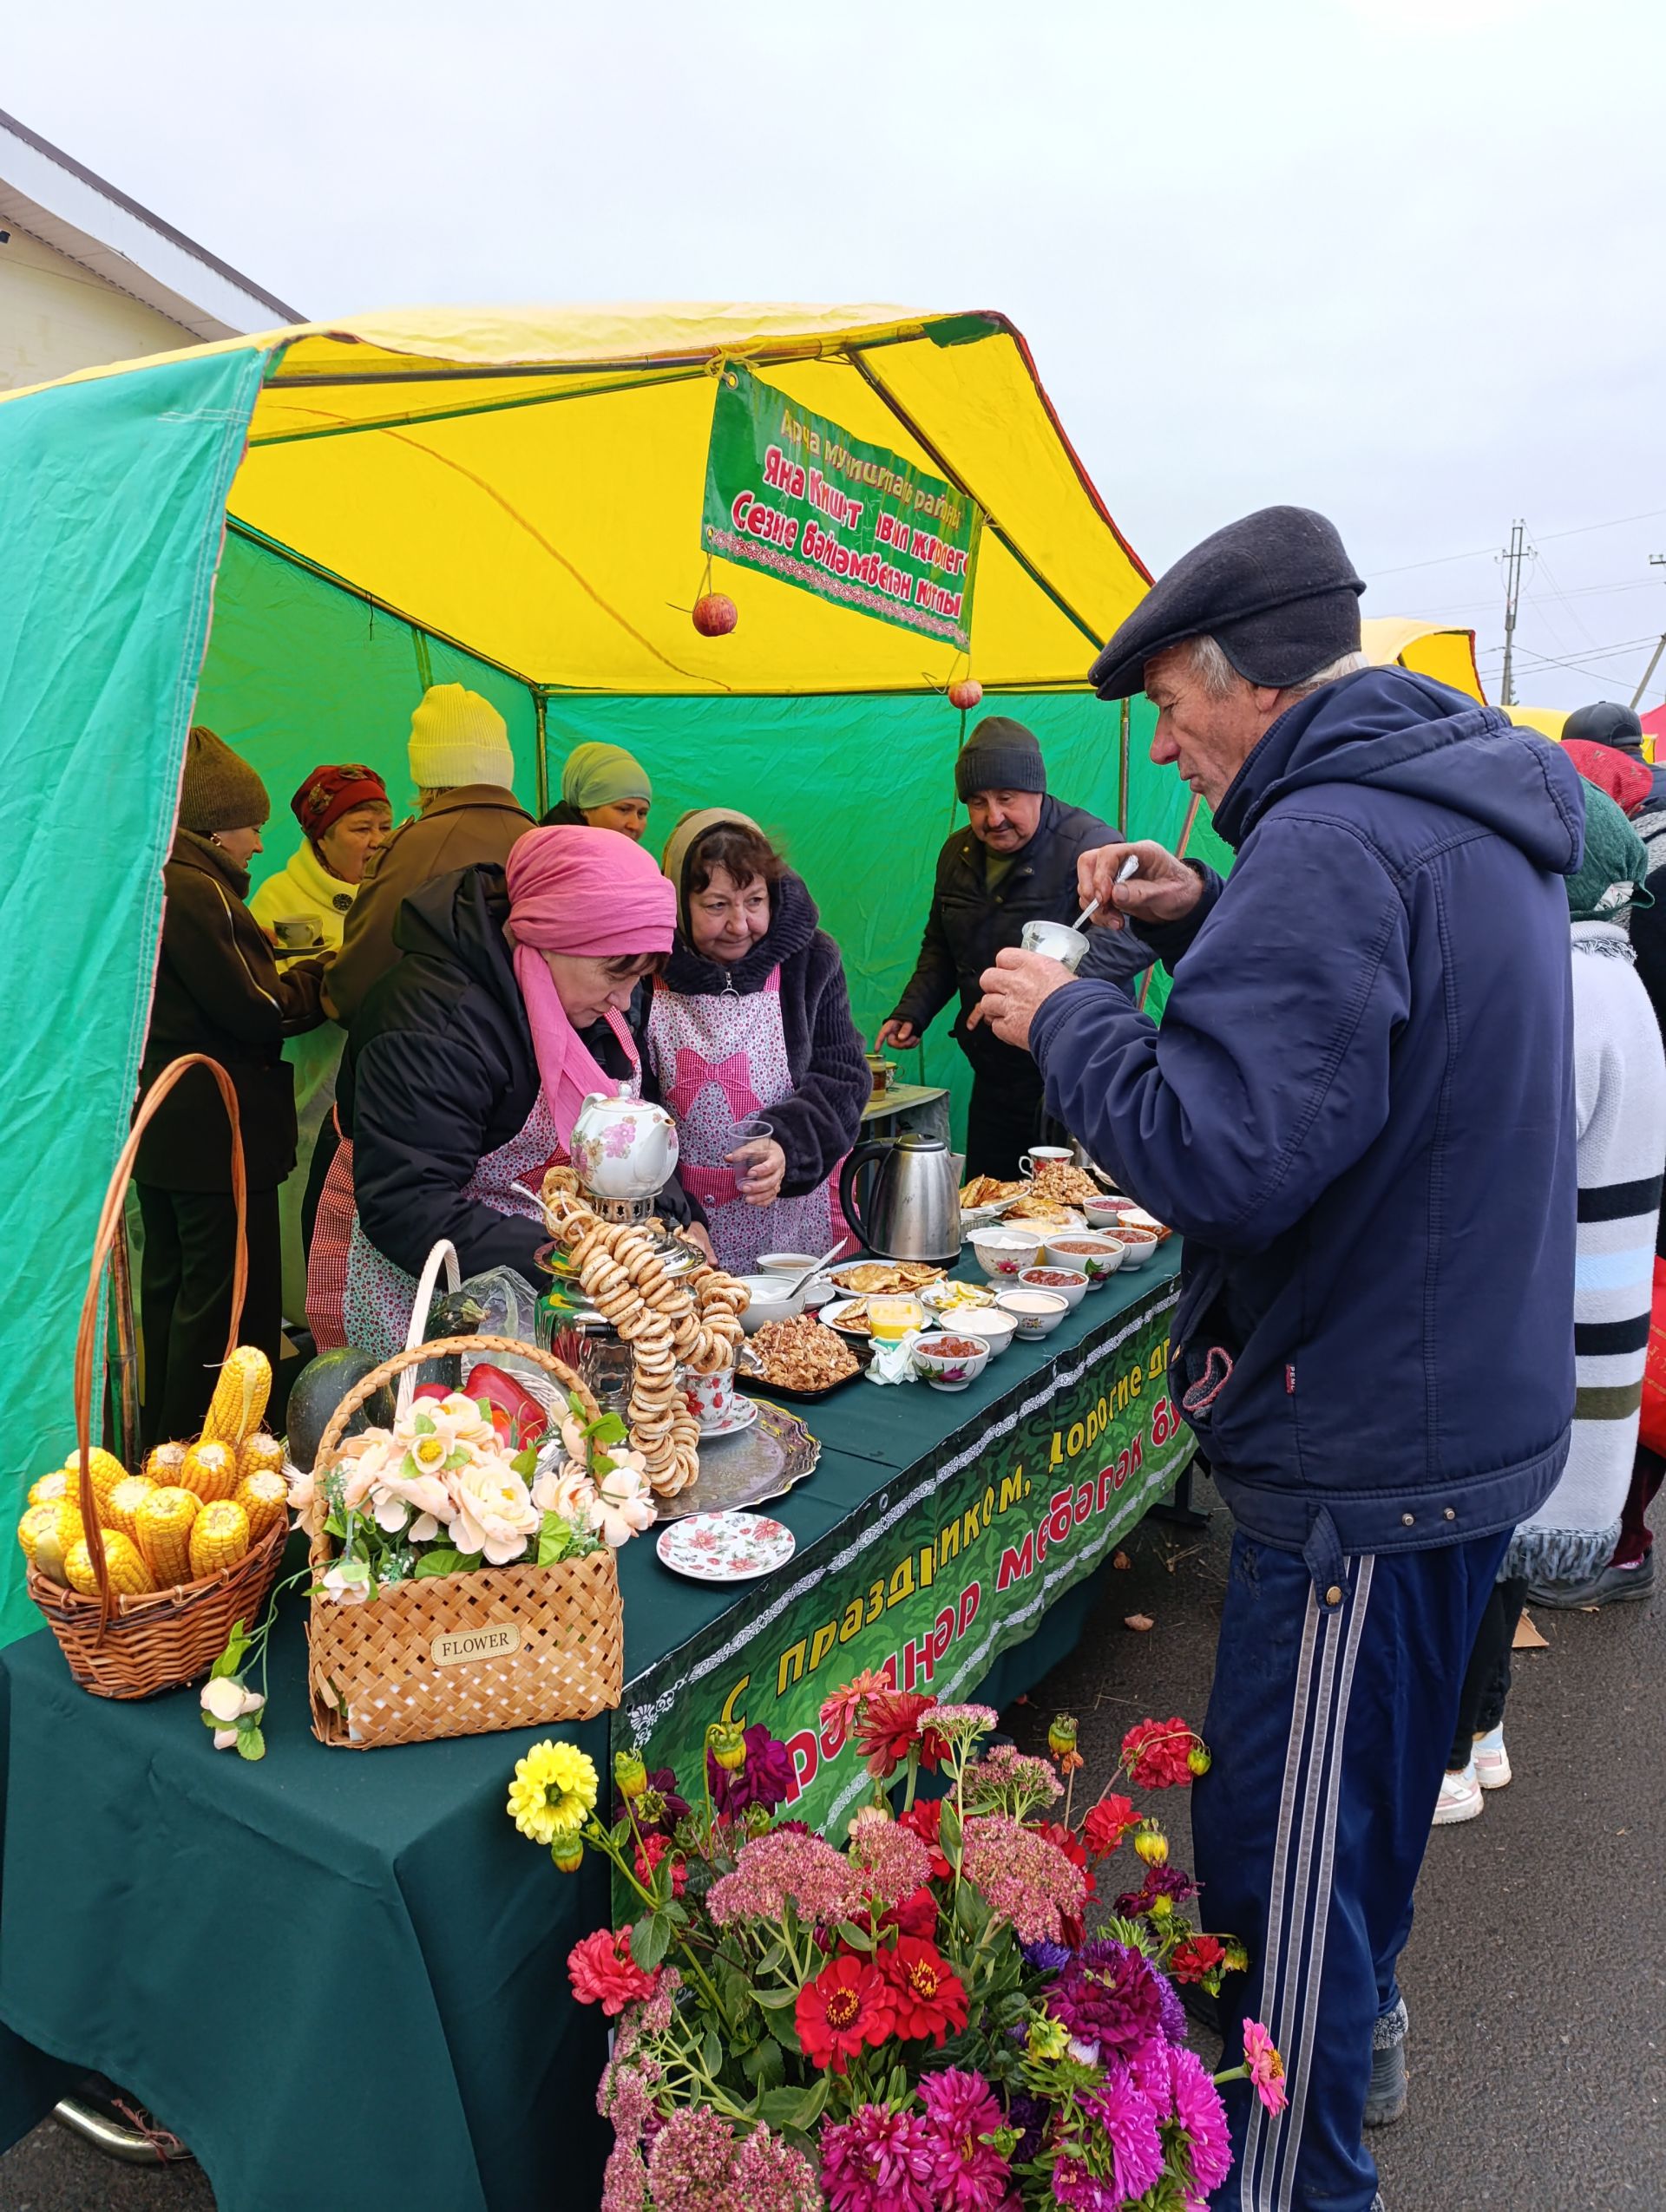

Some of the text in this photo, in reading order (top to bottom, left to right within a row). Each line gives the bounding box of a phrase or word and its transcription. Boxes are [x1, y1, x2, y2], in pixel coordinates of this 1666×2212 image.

[781, 409, 820, 457] Арча
[763, 444, 806, 501] Яңа
[731, 490, 798, 551] Сезне
[442, 1632, 510, 1657] FLOWER
